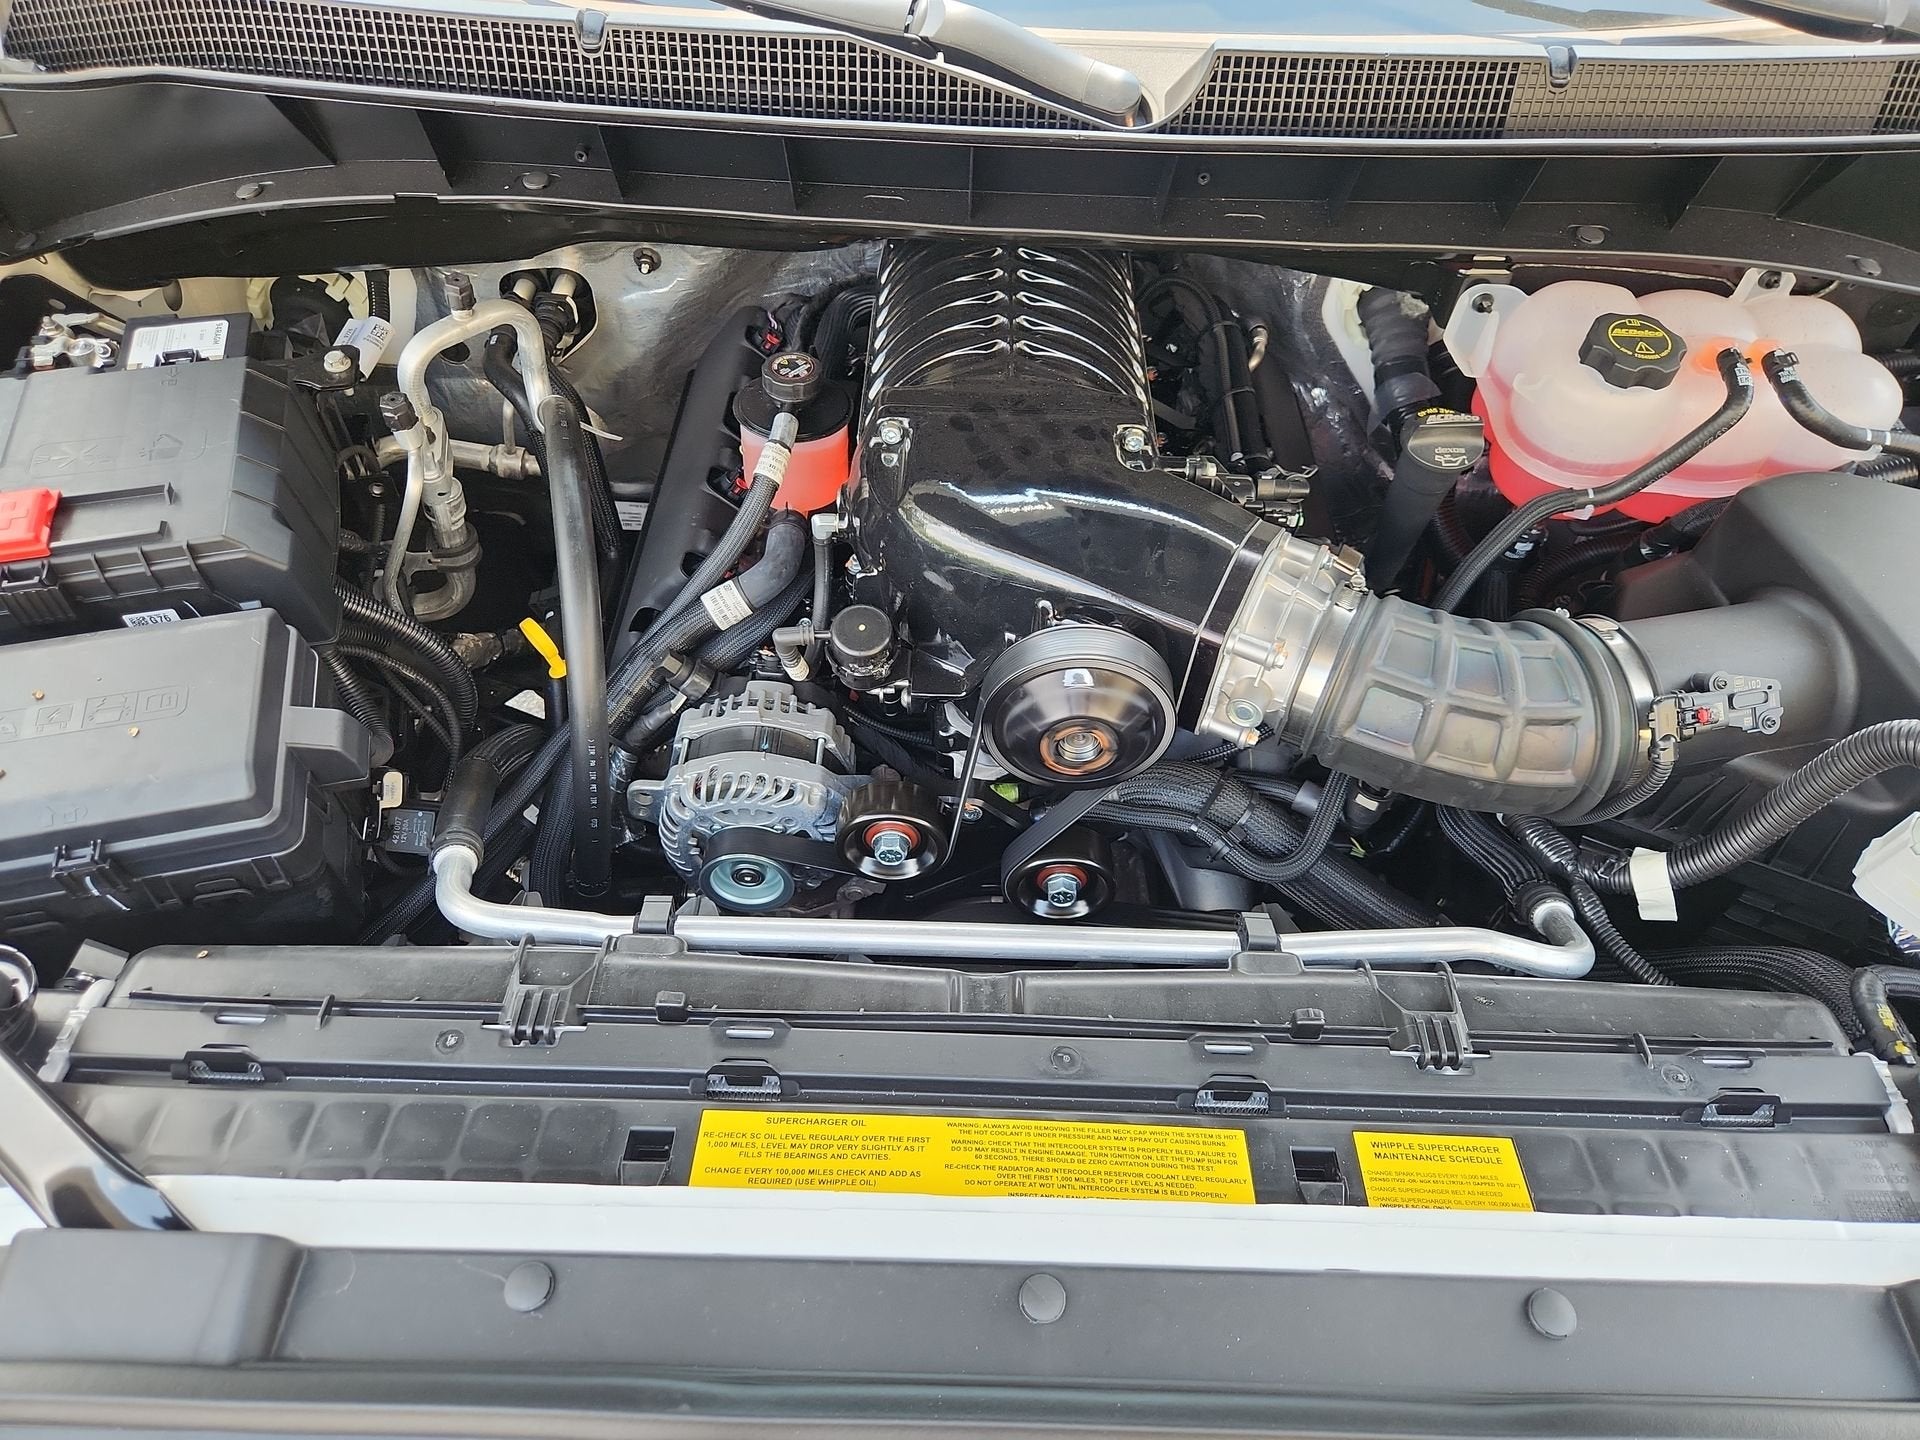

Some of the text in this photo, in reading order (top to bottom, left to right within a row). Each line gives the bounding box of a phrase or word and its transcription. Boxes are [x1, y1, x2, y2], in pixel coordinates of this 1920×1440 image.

[1611, 328, 1664, 338] ACDelco
[1426, 414, 1480, 424] ACDelco
[150, 615, 172, 624] G76
[392, 816, 402, 844] 421007
[766, 1117, 867, 1126] SUPERCHARGER OIL
[1370, 1141, 1500, 1153] WHIPPLE SUPERCHARGER
[1374, 1152, 1503, 1164] MAINTENANCE SCHEDULE
[748, 1177, 792, 1186] REQUIRED
